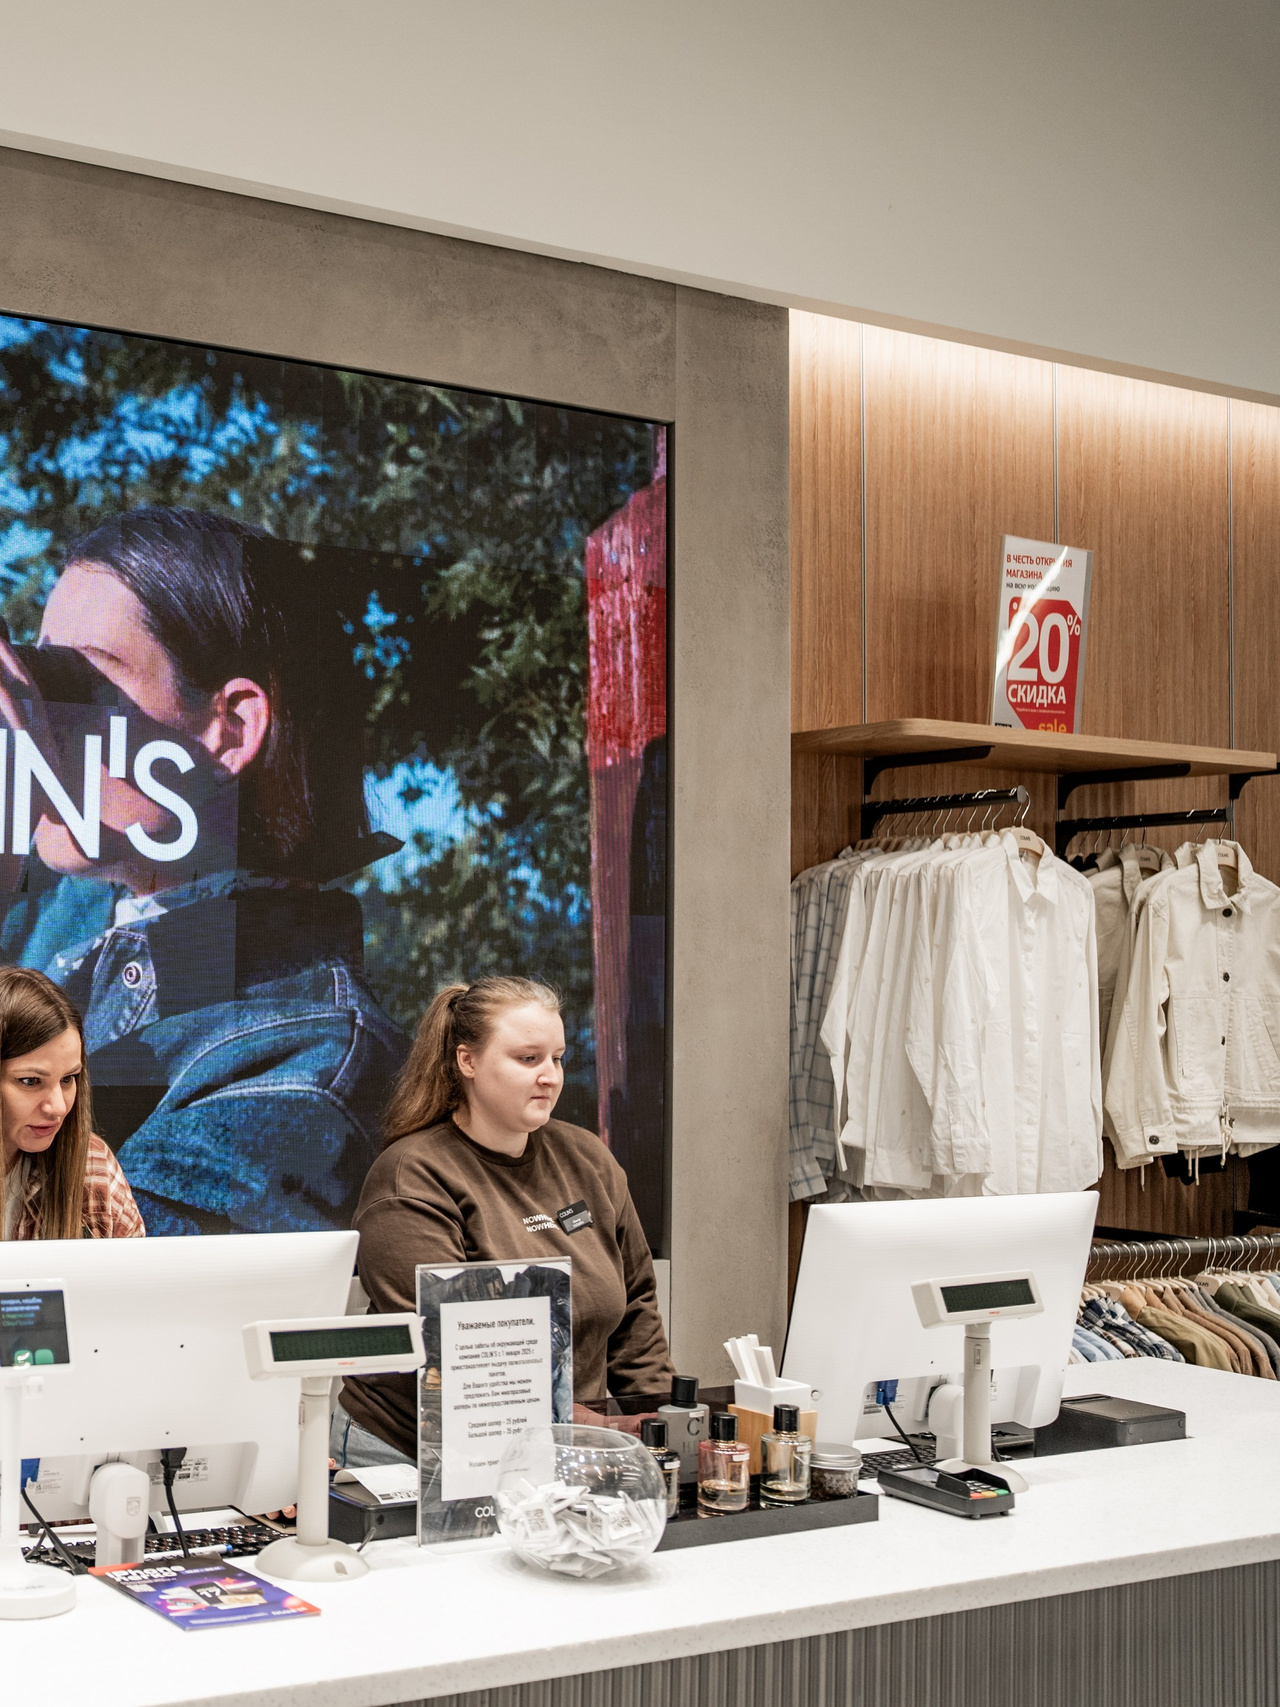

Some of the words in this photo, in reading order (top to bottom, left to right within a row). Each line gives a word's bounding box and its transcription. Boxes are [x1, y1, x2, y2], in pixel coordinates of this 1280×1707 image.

[1006, 554, 1012, 563] В
[1013, 554, 1035, 565] ЧЕСТЬ
[1035, 556, 1073, 568] ОТКРИЯ
[1006, 568, 1043, 580] МАГАЗИНА
[1007, 683, 1067, 708] СКИДКА
[457, 1320, 496, 1331] Уважаемые
[474, 1505, 496, 1518] COL
